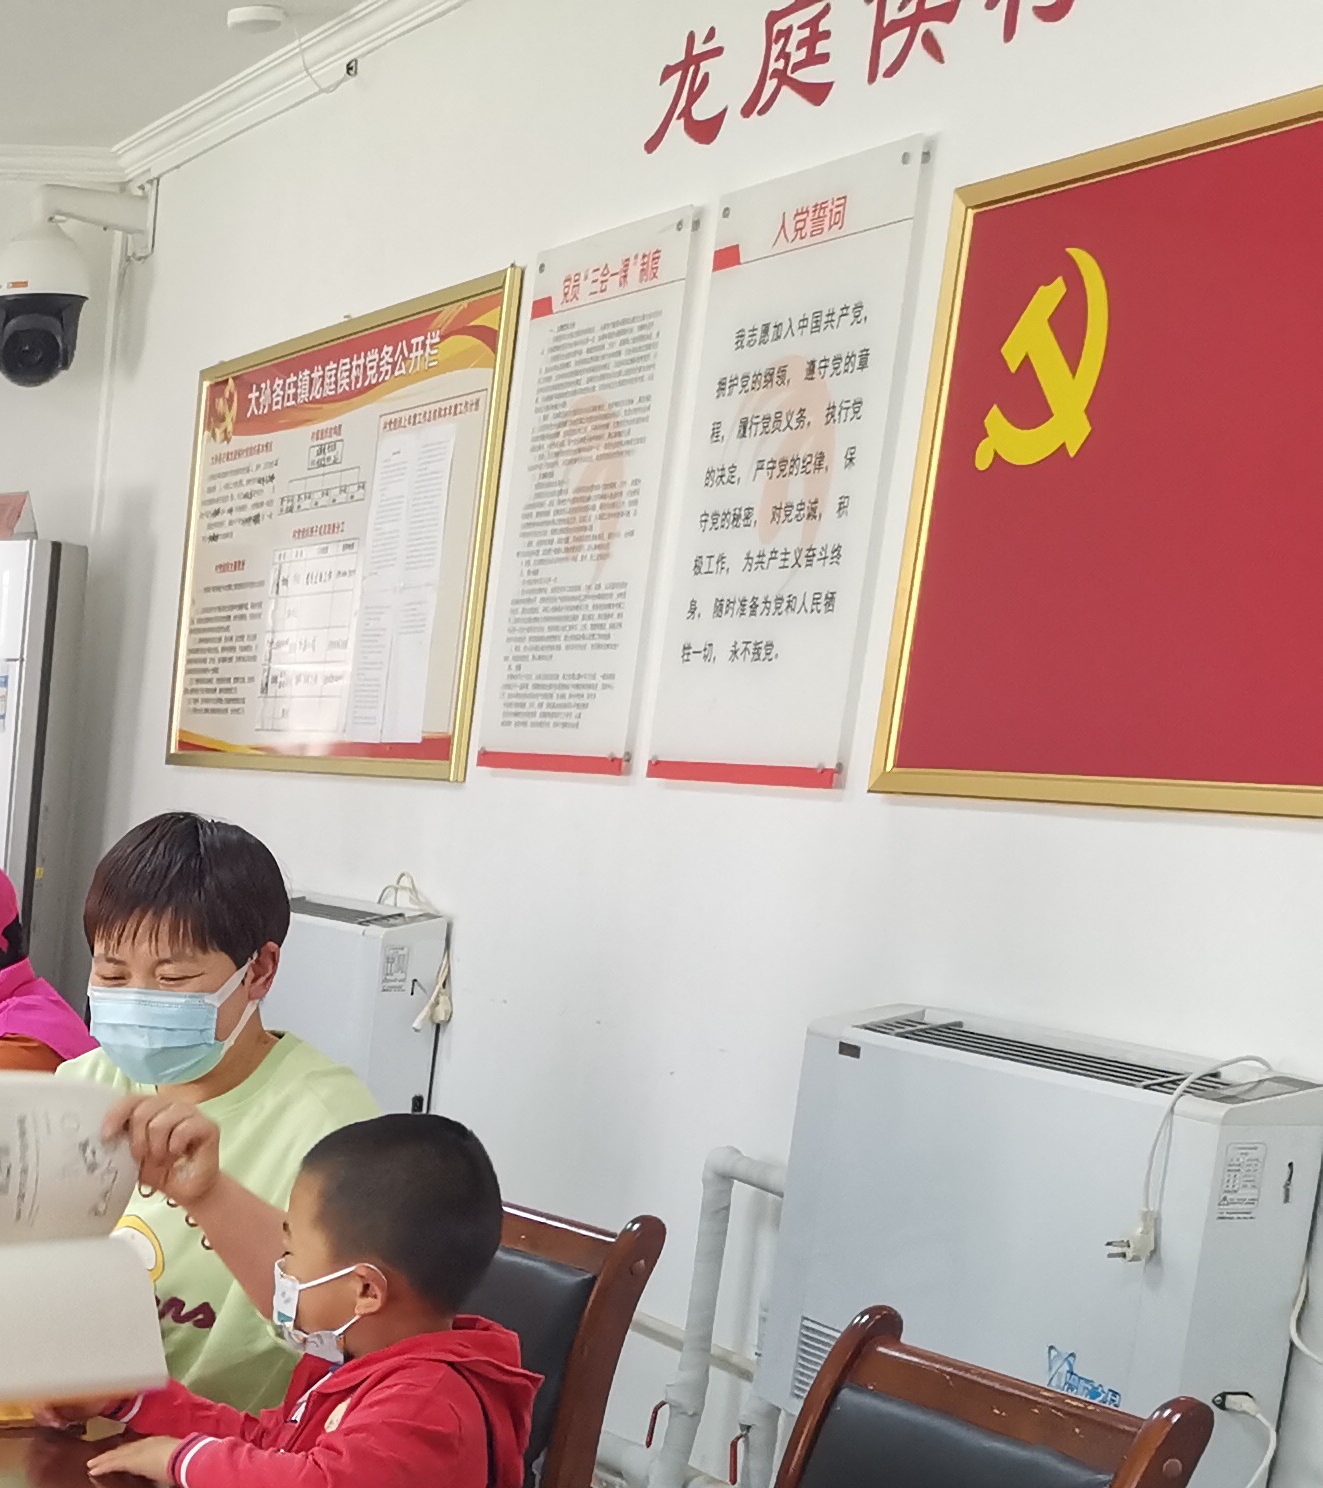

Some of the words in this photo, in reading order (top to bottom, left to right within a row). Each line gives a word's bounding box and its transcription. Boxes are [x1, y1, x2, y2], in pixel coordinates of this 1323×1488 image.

[246, 329, 442, 419] 大孙各庄镇龙庭侯村党务公开栏
